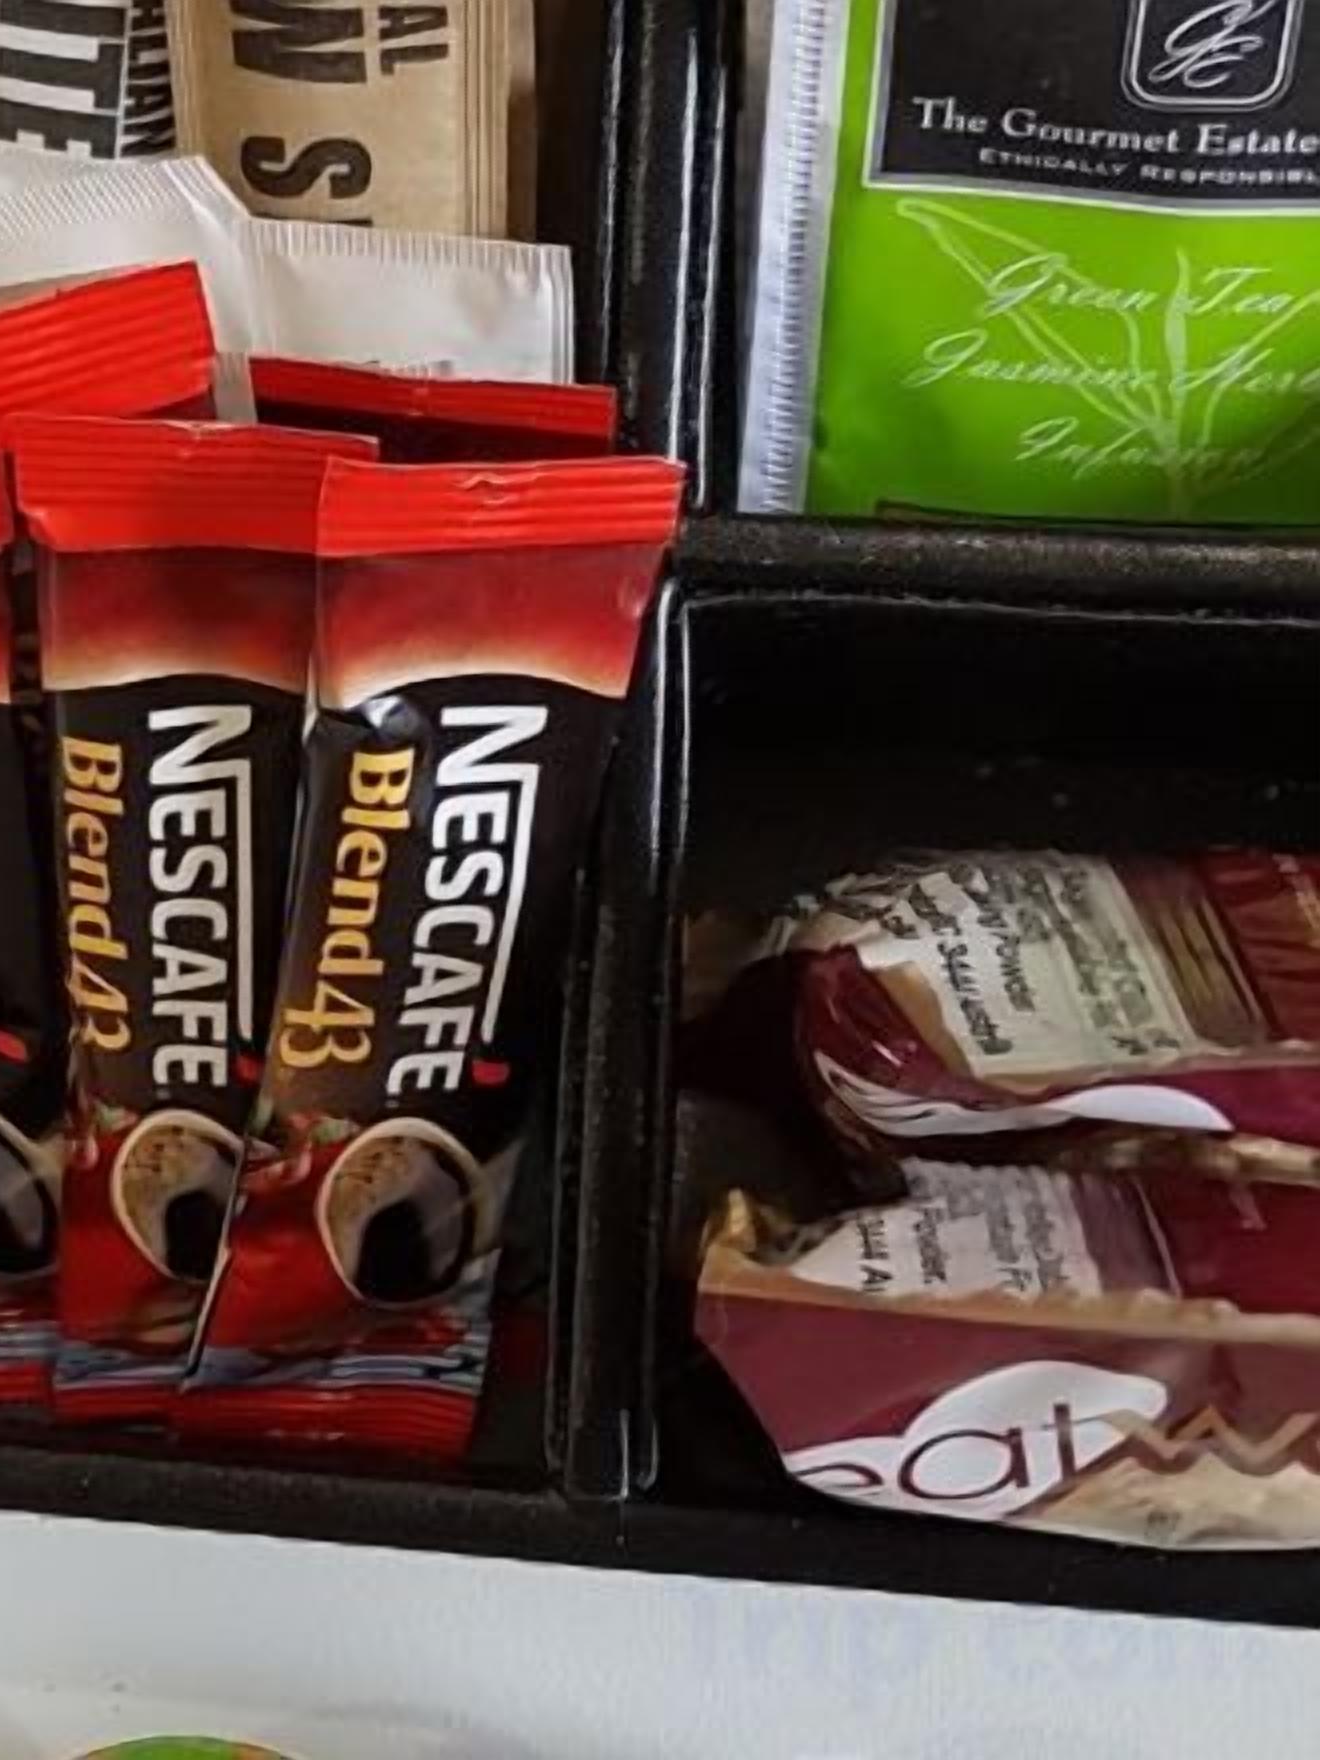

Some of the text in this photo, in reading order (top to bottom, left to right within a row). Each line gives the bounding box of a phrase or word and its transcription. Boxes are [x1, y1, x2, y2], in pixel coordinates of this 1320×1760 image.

[912, 97, 988, 133] The
[1000, 107, 1182, 154] Gourmet
[60, 735, 130, 960] Blend
[280, 747, 416, 1069] Blend 43
